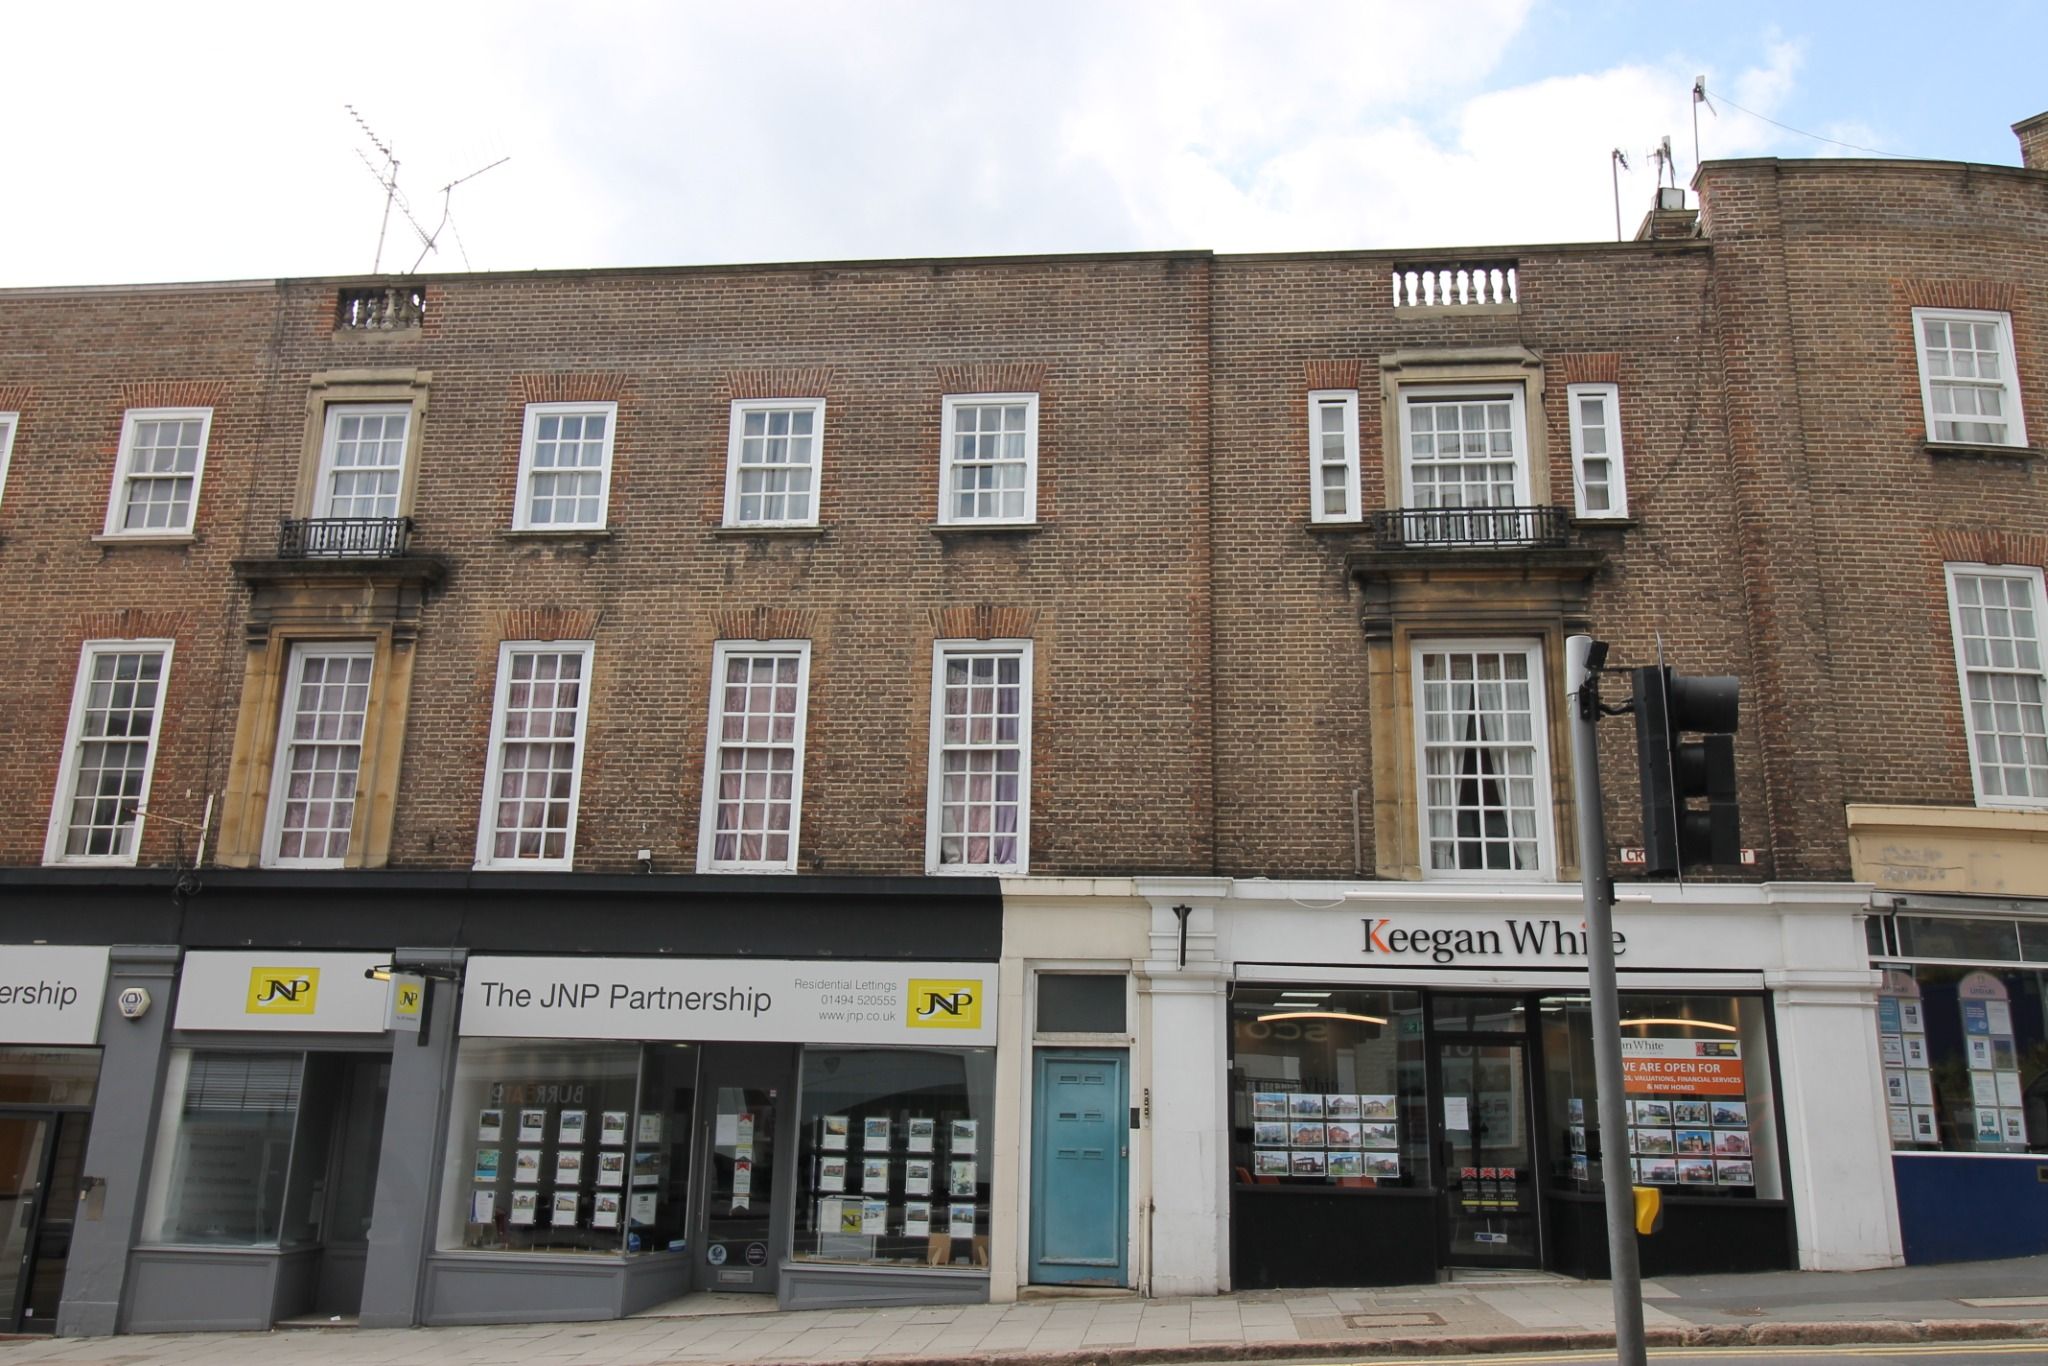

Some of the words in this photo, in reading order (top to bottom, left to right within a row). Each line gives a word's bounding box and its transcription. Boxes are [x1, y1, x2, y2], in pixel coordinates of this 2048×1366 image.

[1626, 849, 1645, 861] CR
[1361, 919, 1503, 964] Keegan
[1505, 920, 1626, 956] Whie
[256, 979, 311, 1002] JNP
[794, 978, 852, 990] Residential
[855, 979, 897, 993] Lettings
[0, 980, 77, 1011] ership
[480, 981, 532, 1008] The
[540, 983, 600, 1009] JNP
[609, 984, 772, 1018] Partnership
[820, 994, 854, 1005] 01494
[857, 994, 897, 1006] 520555
[916, 992, 973, 1016] JNP
[818, 1011, 896, 1023] www.jnp.co.uk
[1633, 1040, 1665, 1050] White
[1638, 1062, 1661, 1073] ARE
[1663, 1062, 1696, 1073] OPEN
[1698, 1063, 1721, 1074] FOR
[1677, 1075, 1711, 1083] FINANCIAL
[1711, 1076, 1742, 1084] SERVICES
